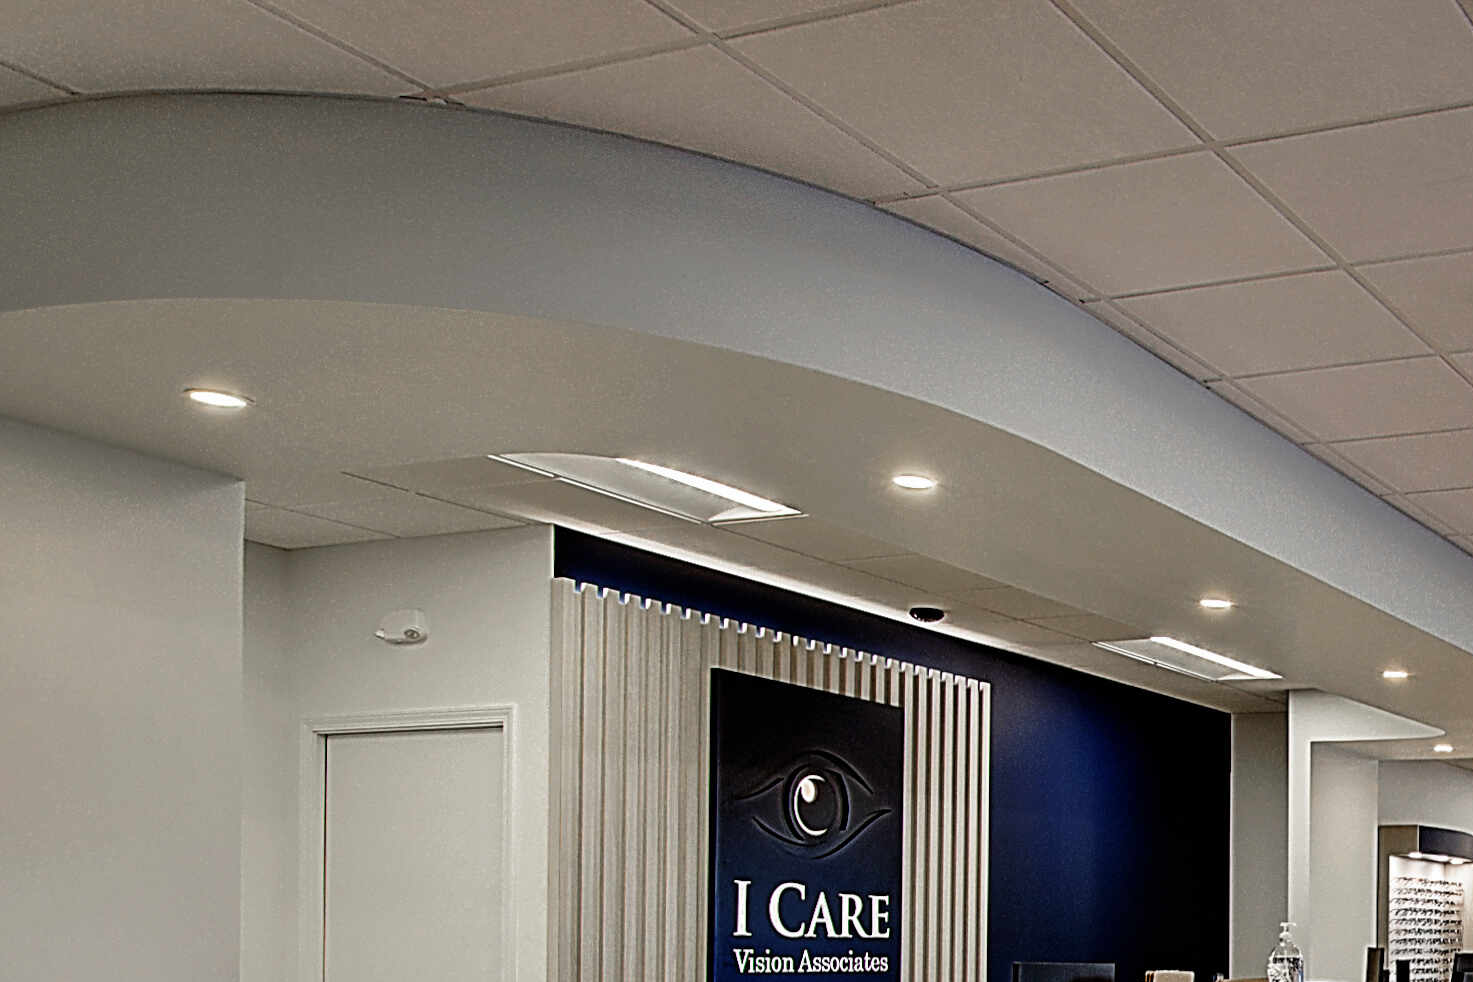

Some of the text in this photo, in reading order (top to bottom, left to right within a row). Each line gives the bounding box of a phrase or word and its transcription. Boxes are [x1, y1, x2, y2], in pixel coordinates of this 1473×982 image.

[732, 880, 891, 939] I CARE
[733, 948, 889, 974] Vision Associates
